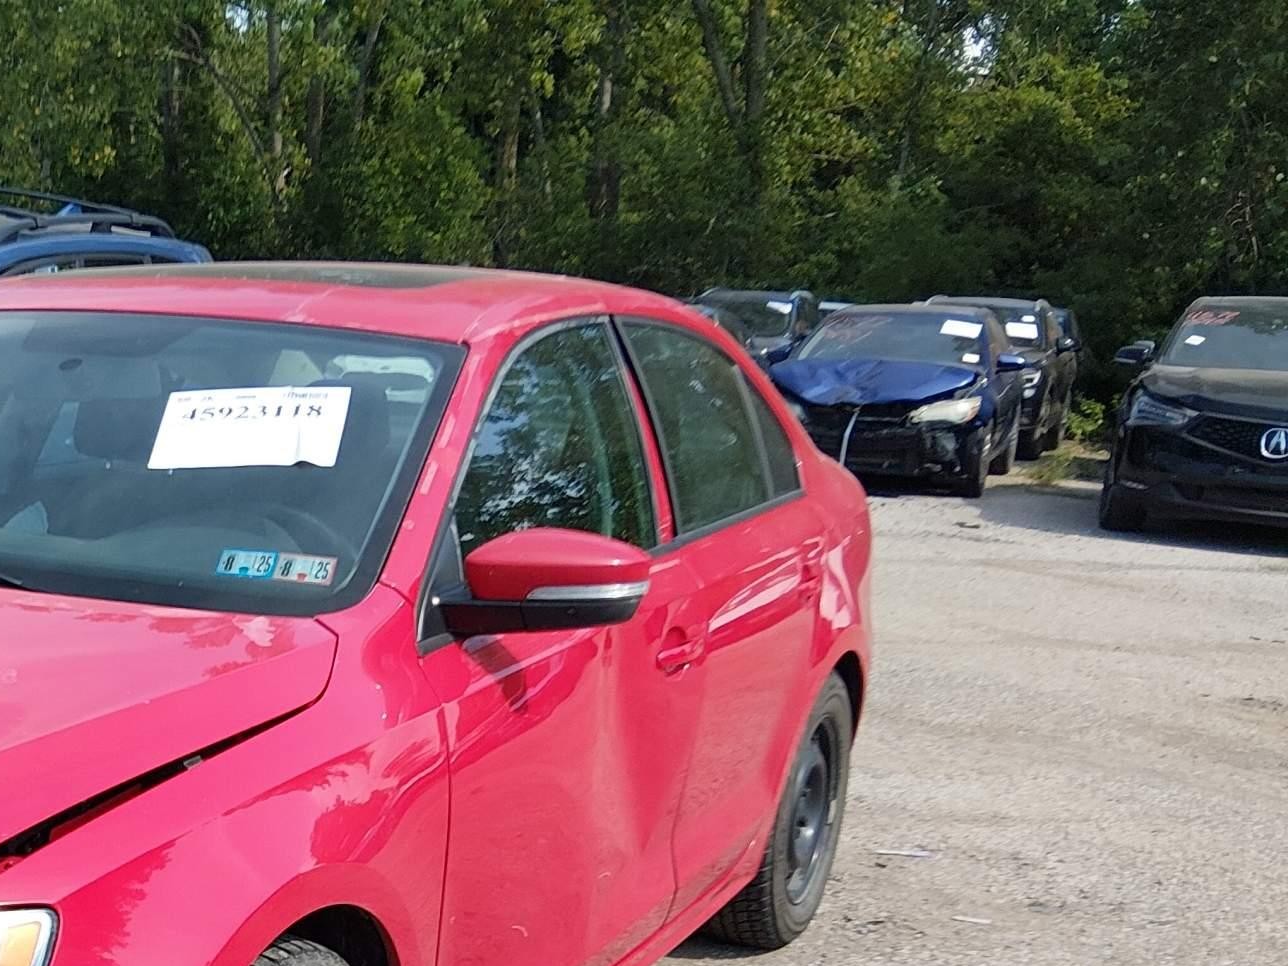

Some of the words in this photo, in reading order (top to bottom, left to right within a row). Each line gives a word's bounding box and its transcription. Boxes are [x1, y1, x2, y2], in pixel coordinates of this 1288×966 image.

[181, 404, 323, 421] 45923118
[256, 555, 272, 573] 25
[314, 561, 331, 580] 25
